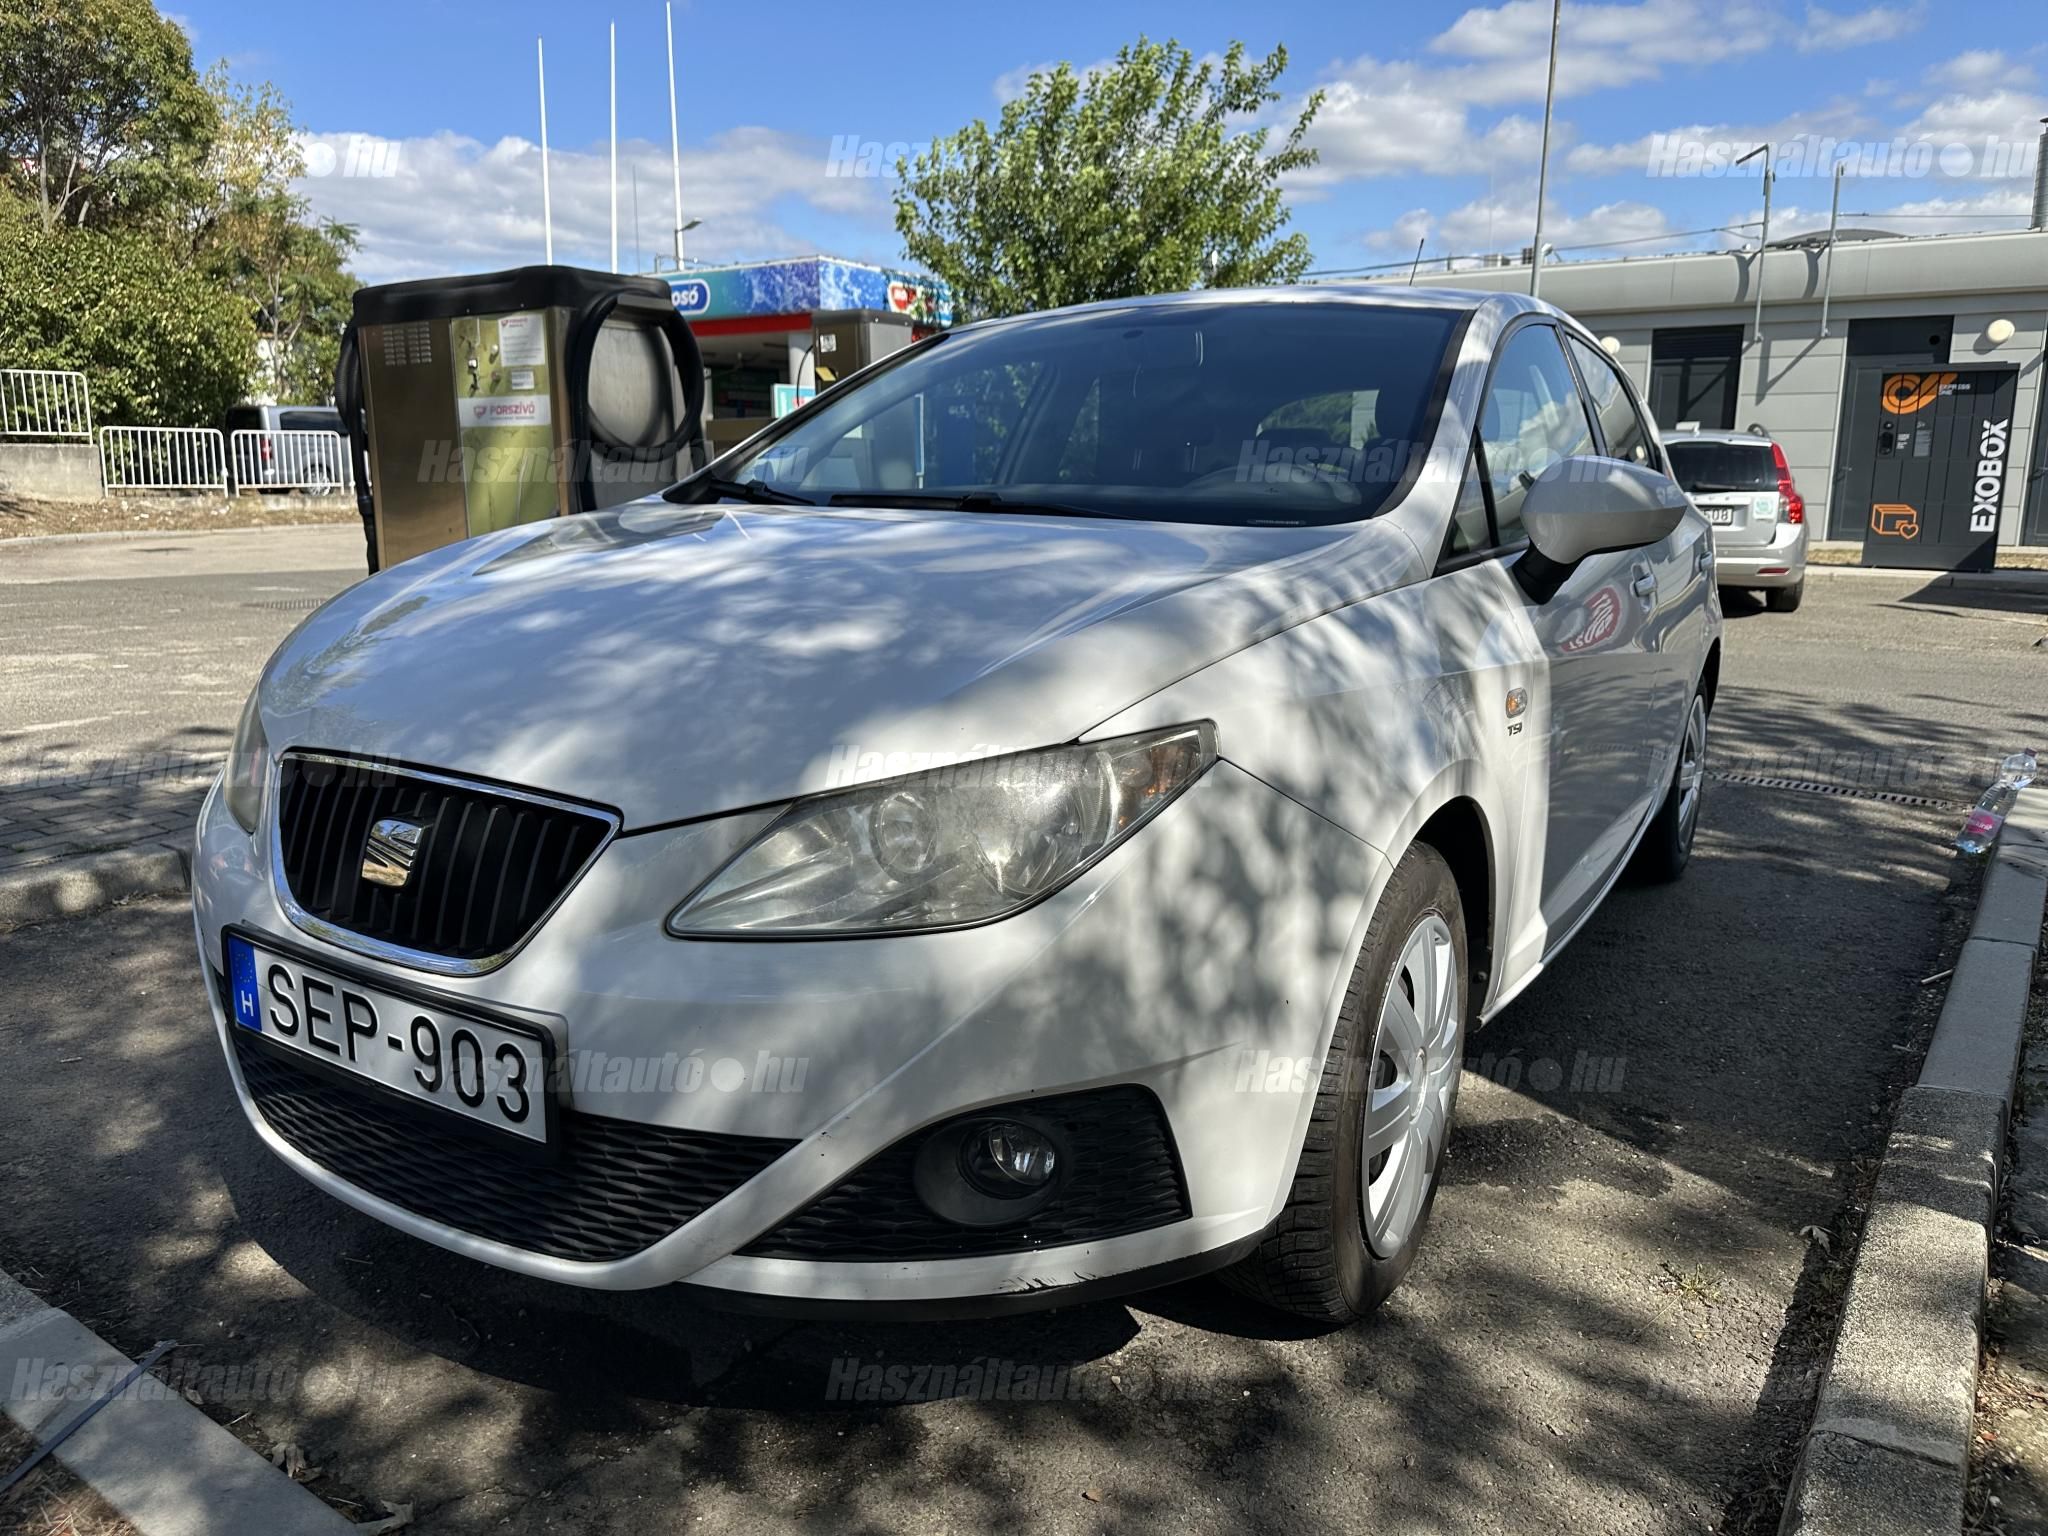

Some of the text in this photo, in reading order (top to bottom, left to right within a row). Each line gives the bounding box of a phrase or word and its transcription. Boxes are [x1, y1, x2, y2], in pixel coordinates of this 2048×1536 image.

[1969, 418, 2008, 532] EXOBOX
[241, 990, 254, 1017] H
[267, 962, 530, 1124] SEP-903
